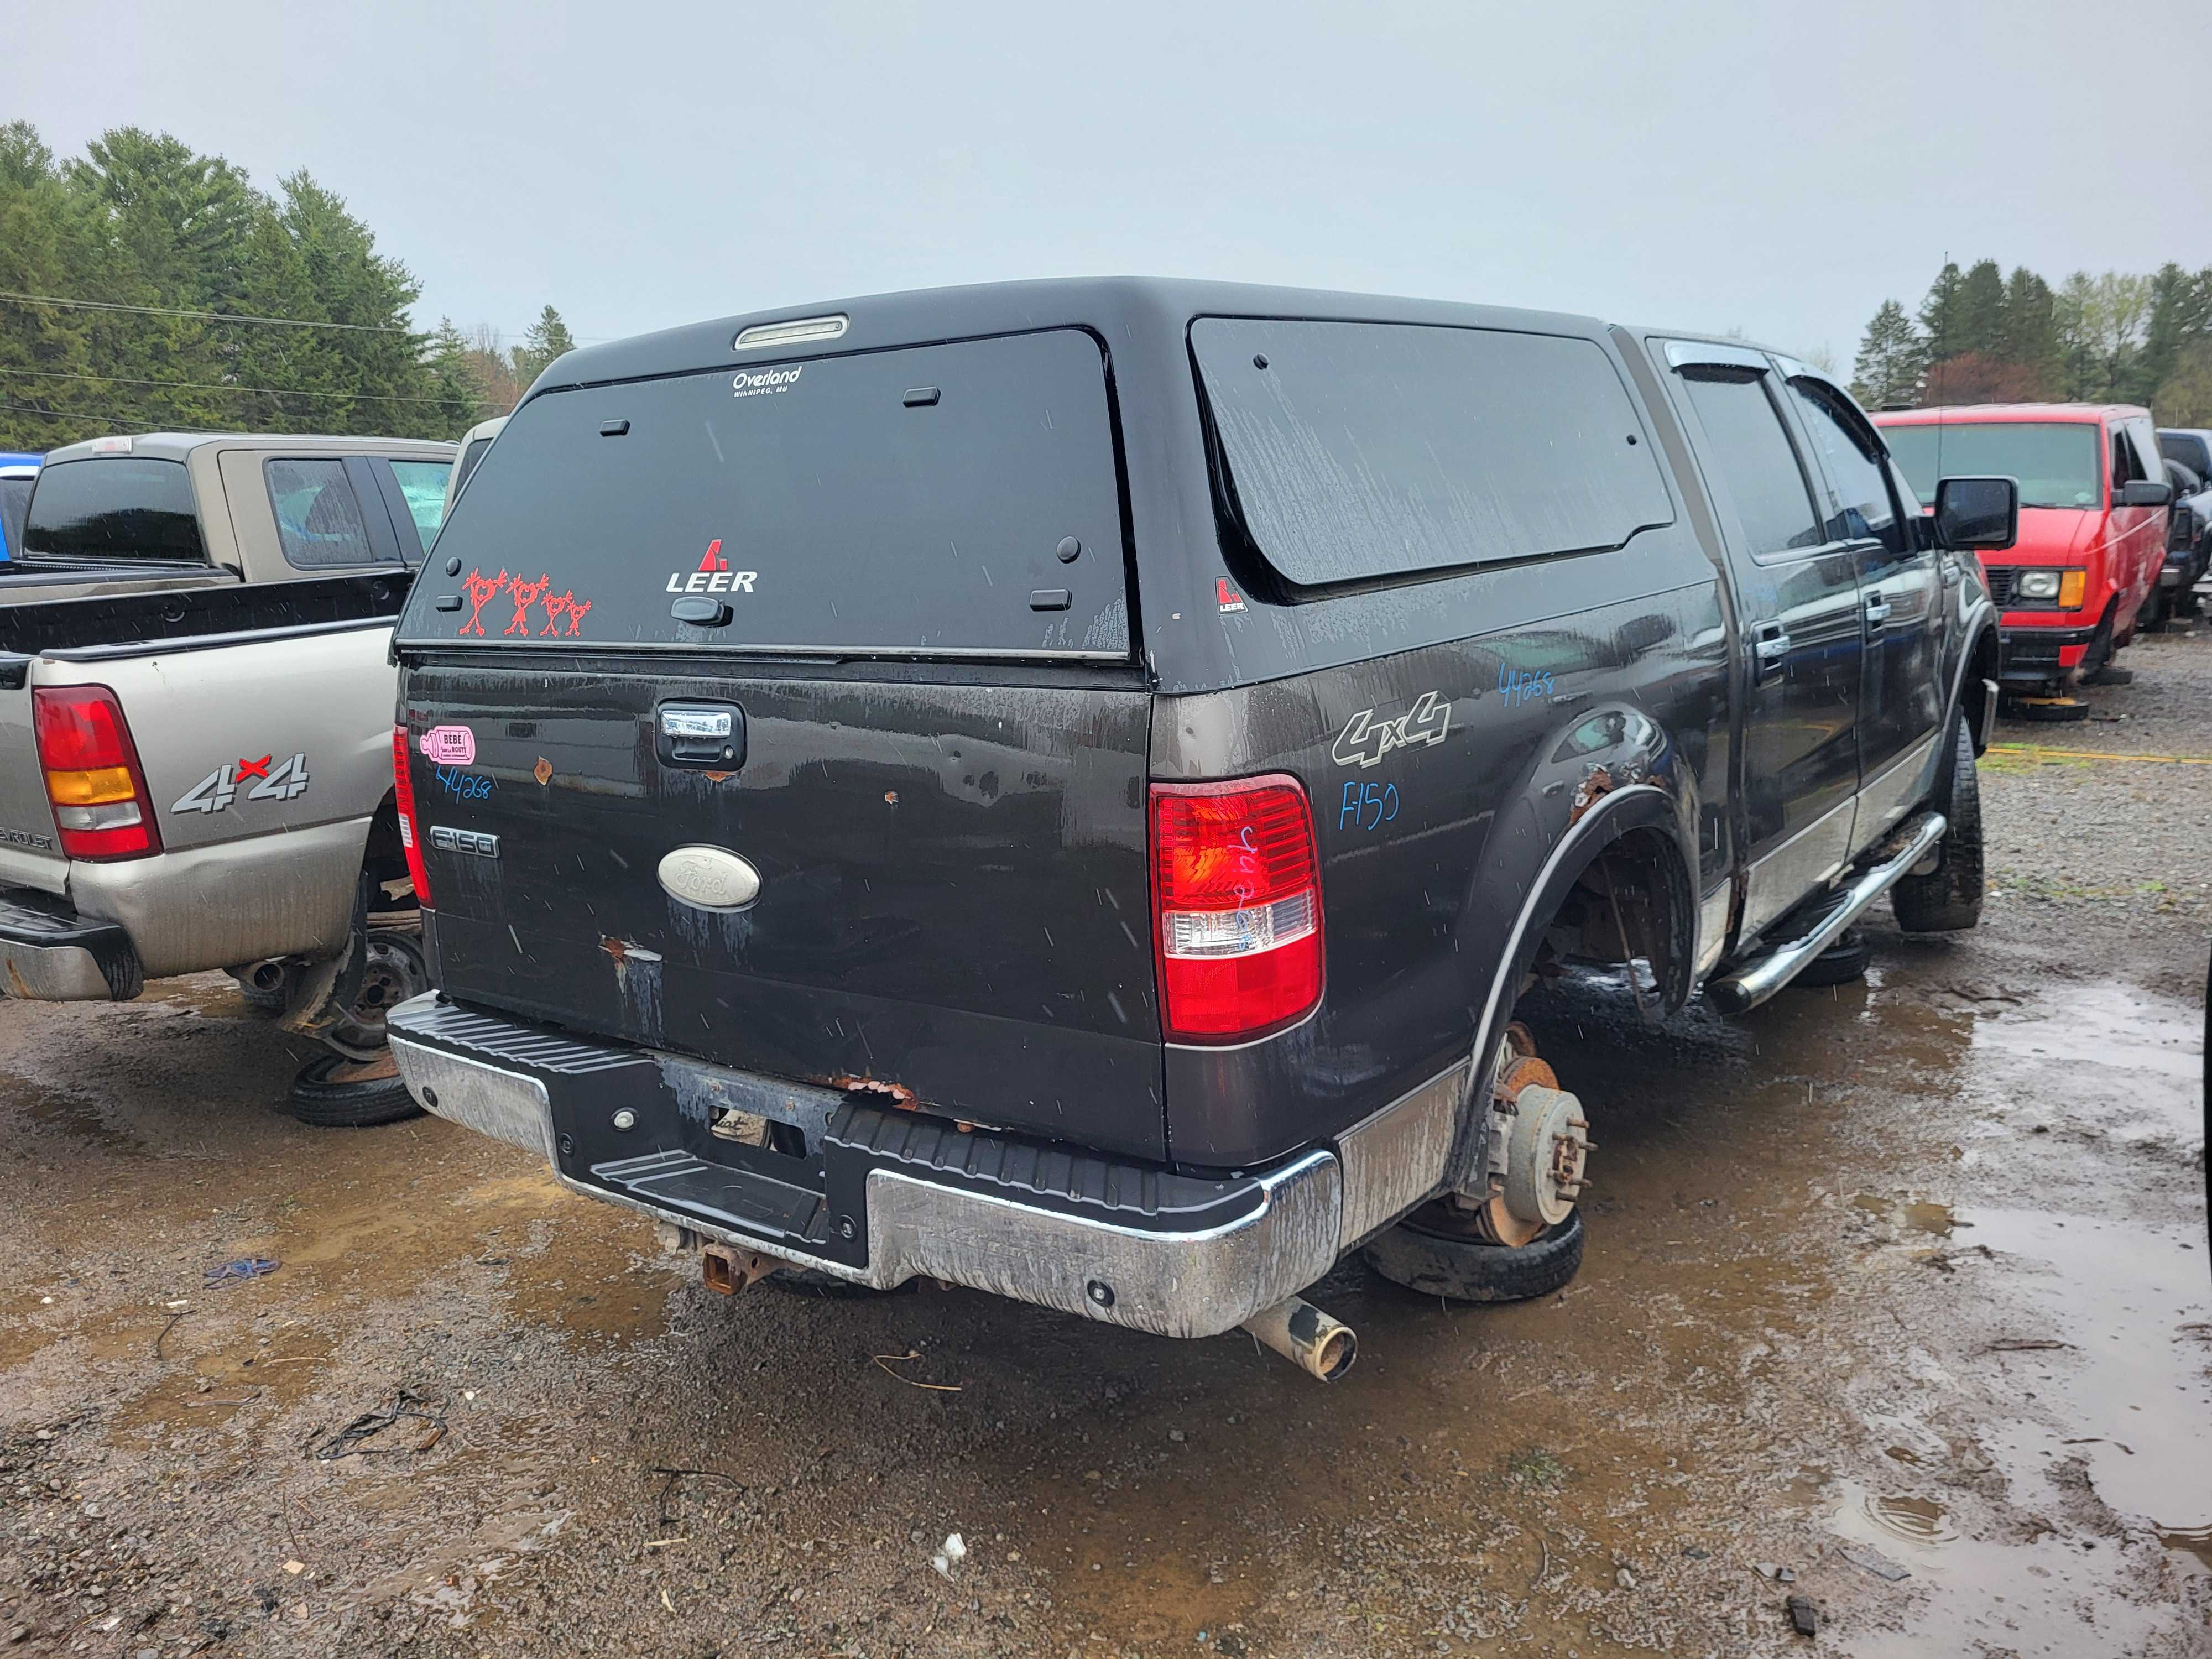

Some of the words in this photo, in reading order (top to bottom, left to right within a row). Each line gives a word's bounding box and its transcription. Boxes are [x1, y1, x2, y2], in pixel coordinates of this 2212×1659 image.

[733, 366, 802, 389] Overland
[666, 572, 758, 593] LEER
[1219, 602, 1245, 612] LEER
[1498, 662, 1556, 708] 44268
[444, 732, 462, 744] BÉBÉ
[1332, 691, 1452, 769] 4x4
[436, 765, 493, 804] 44268
[675, 857, 727, 895] Ford
